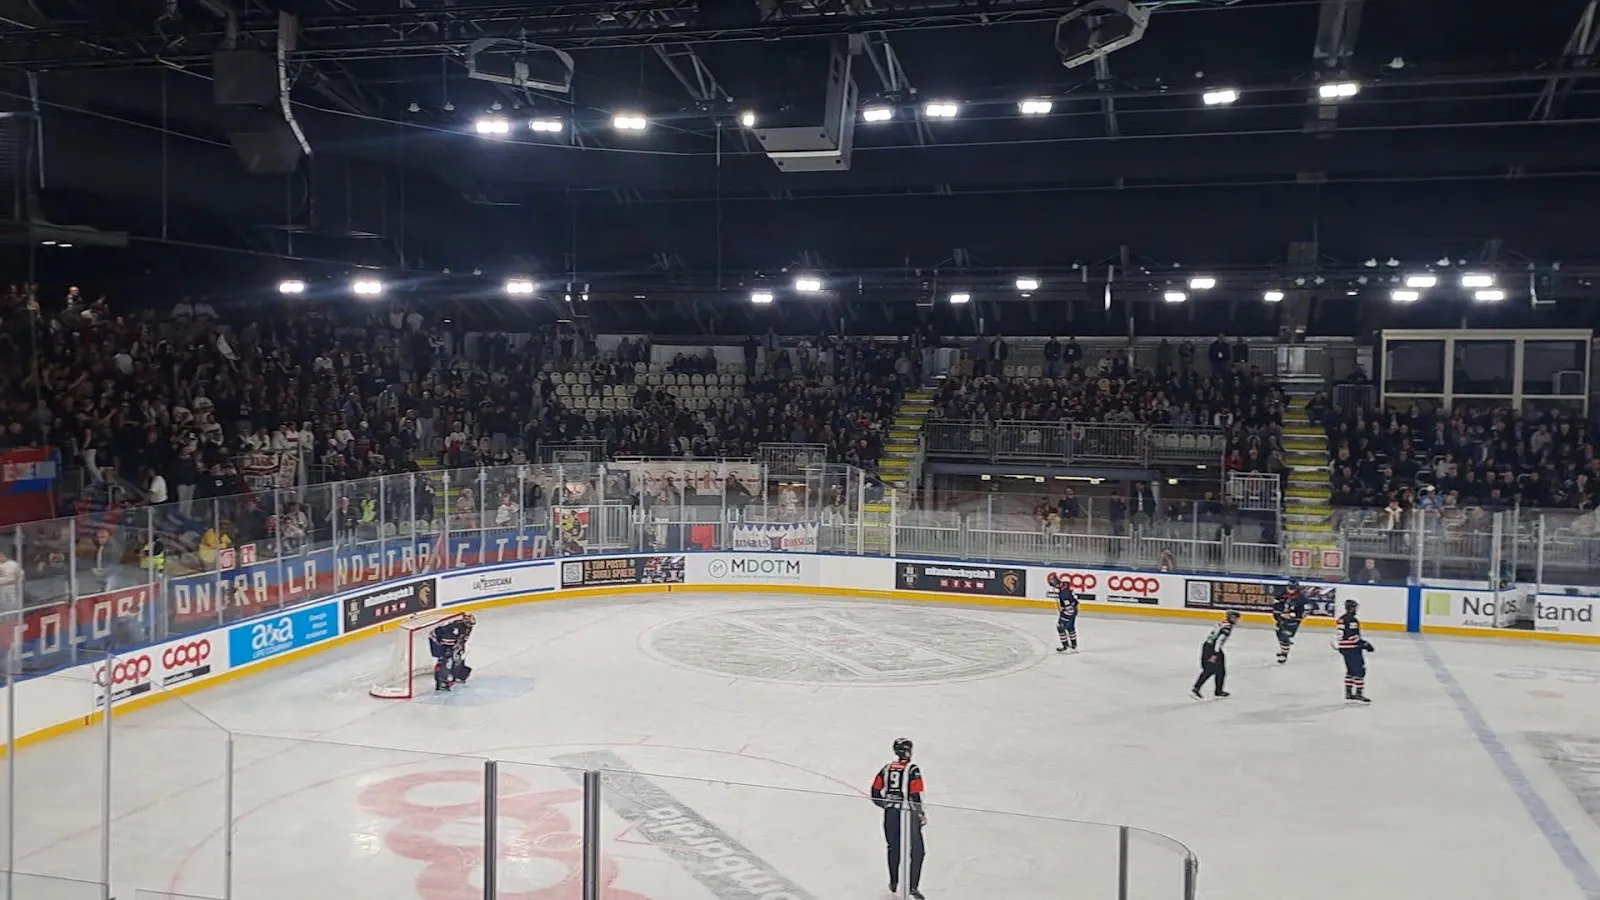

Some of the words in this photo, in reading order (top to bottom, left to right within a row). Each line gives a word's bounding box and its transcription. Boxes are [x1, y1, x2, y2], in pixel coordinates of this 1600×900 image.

[287, 559, 317, 594] LA
[336, 542, 432, 586] NOSTRA
[731, 559, 800, 575] MDOTM
[1107, 575, 1160, 597] coop
[162, 638, 211, 670] coop
[889, 771, 901, 789] 9
